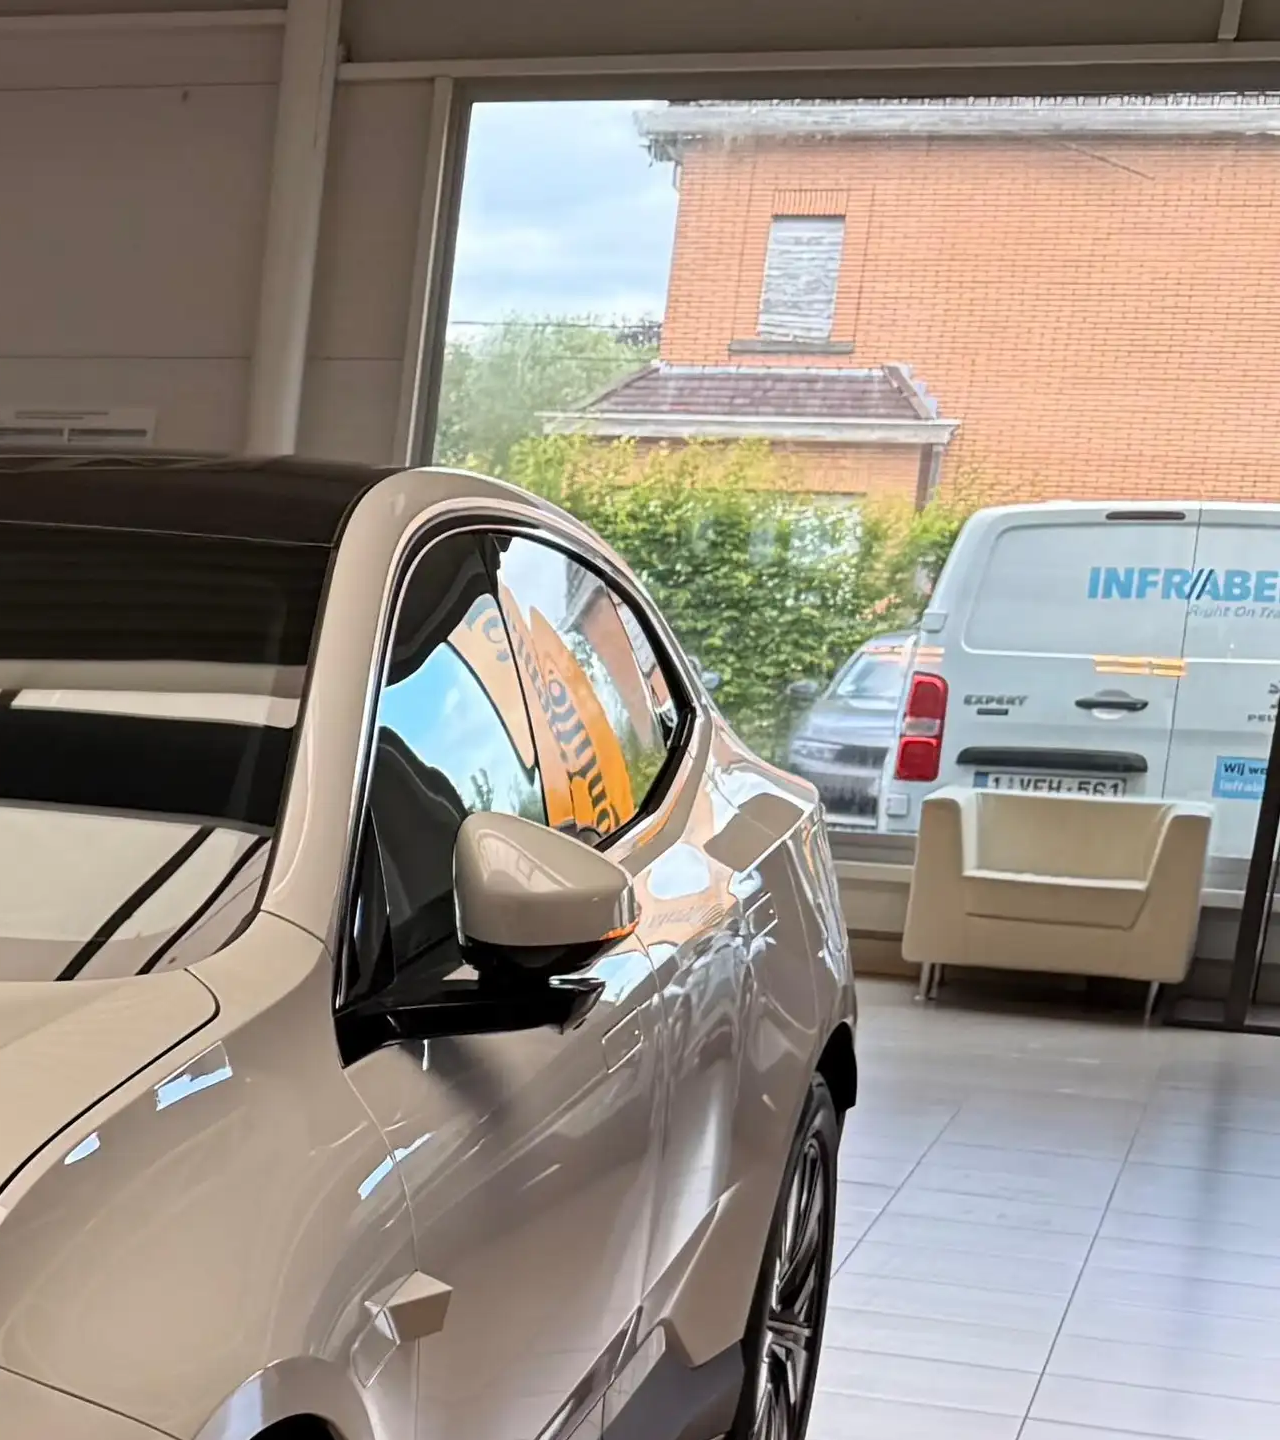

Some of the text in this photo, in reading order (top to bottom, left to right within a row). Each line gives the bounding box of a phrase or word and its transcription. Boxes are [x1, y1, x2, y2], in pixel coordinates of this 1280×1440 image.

[1088, 566, 1280, 603] INFRABE
[1190, 604, 1280, 619] Right On Tra
[1224, 763, 1245, 776] Wij
